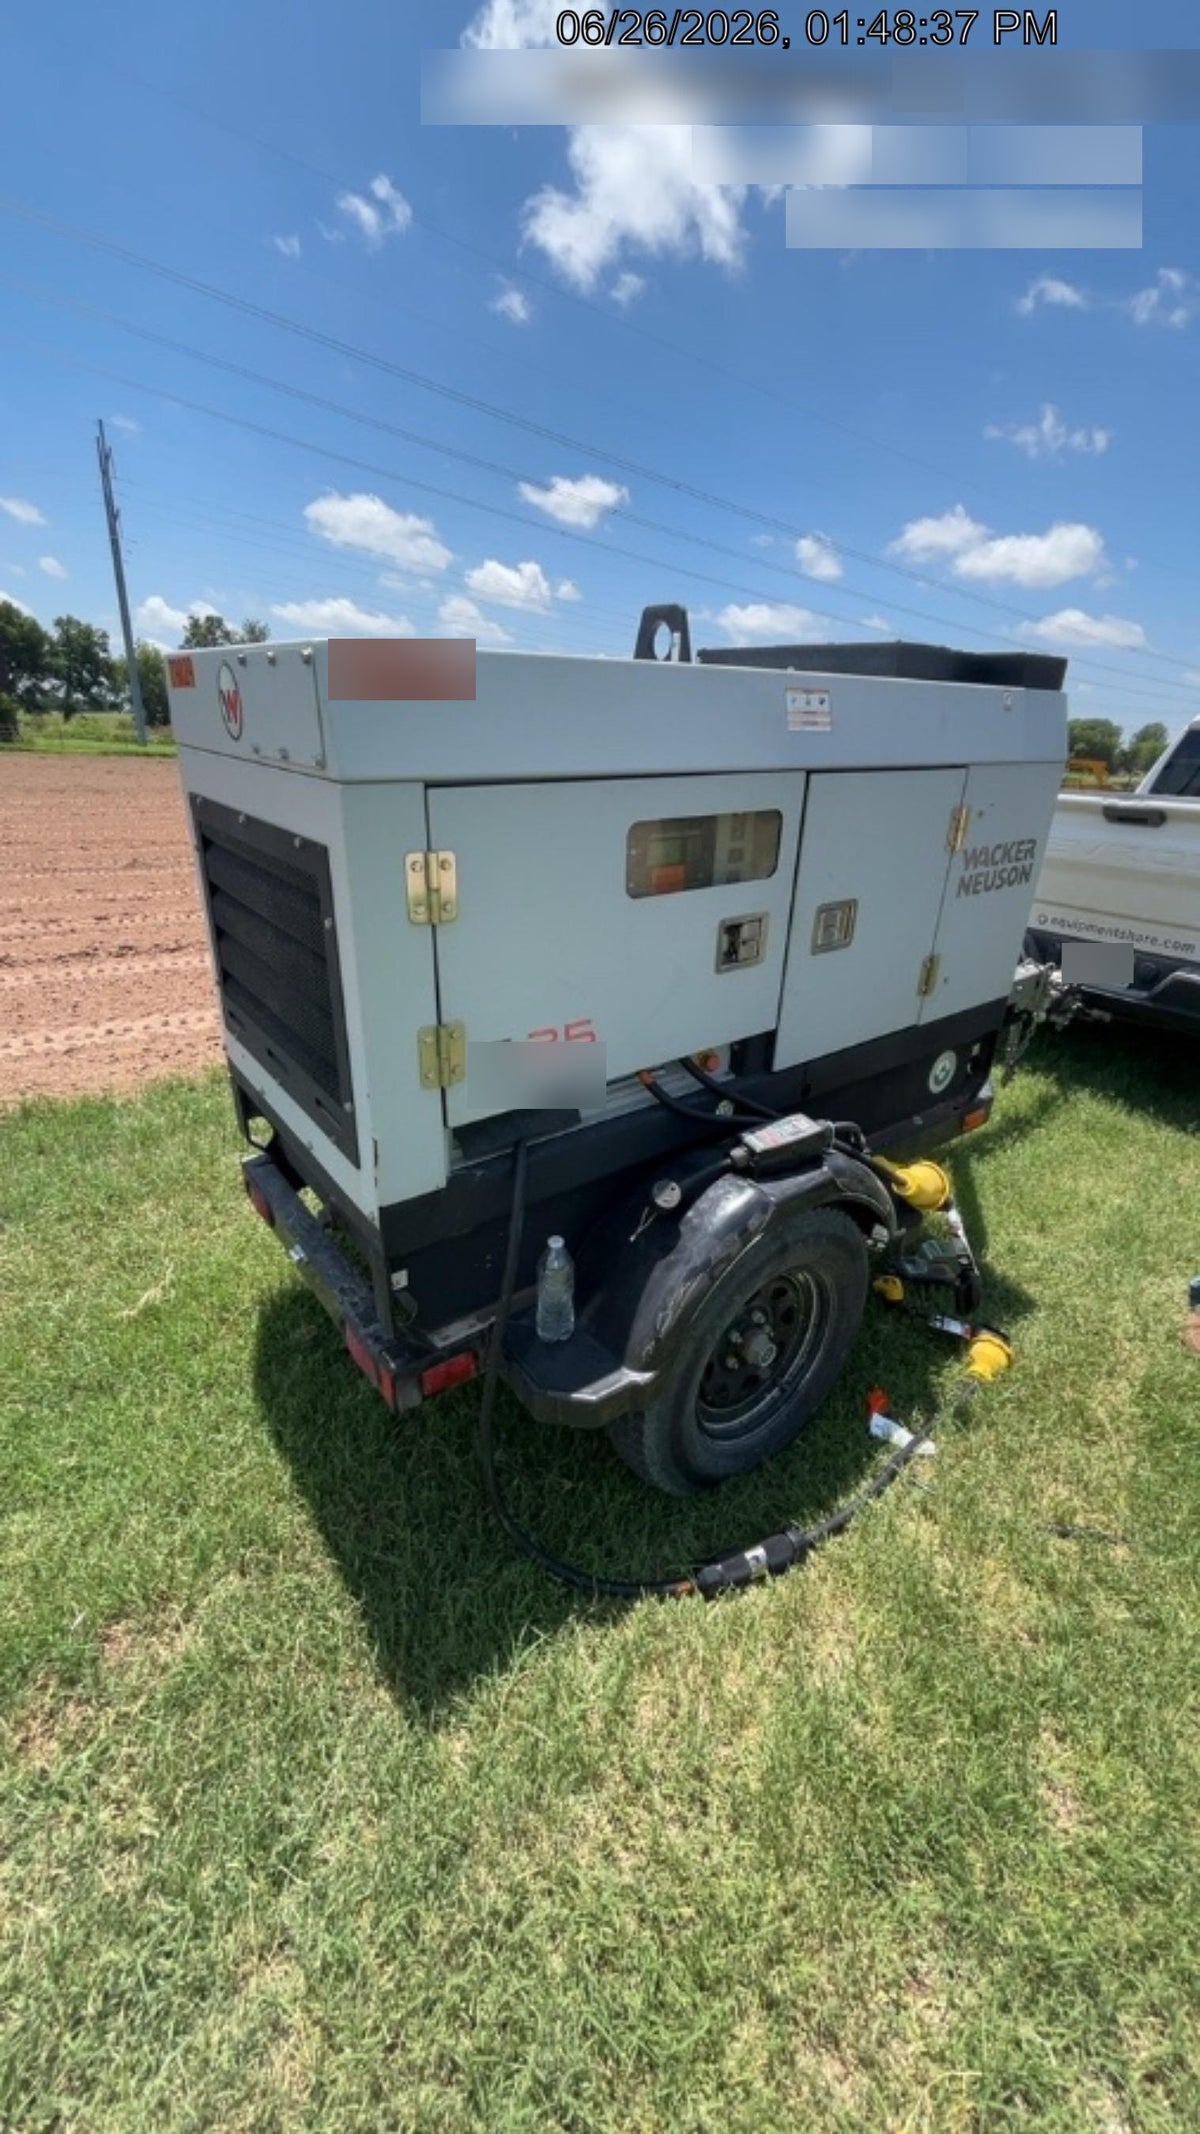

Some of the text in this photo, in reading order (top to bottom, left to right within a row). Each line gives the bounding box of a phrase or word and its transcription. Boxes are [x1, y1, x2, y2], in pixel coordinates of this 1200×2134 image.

[963, 838, 1037, 871] WACKER
[956, 862, 1033, 898] NEUSON
[1051, 915, 1196, 953] equipmentshare.com
